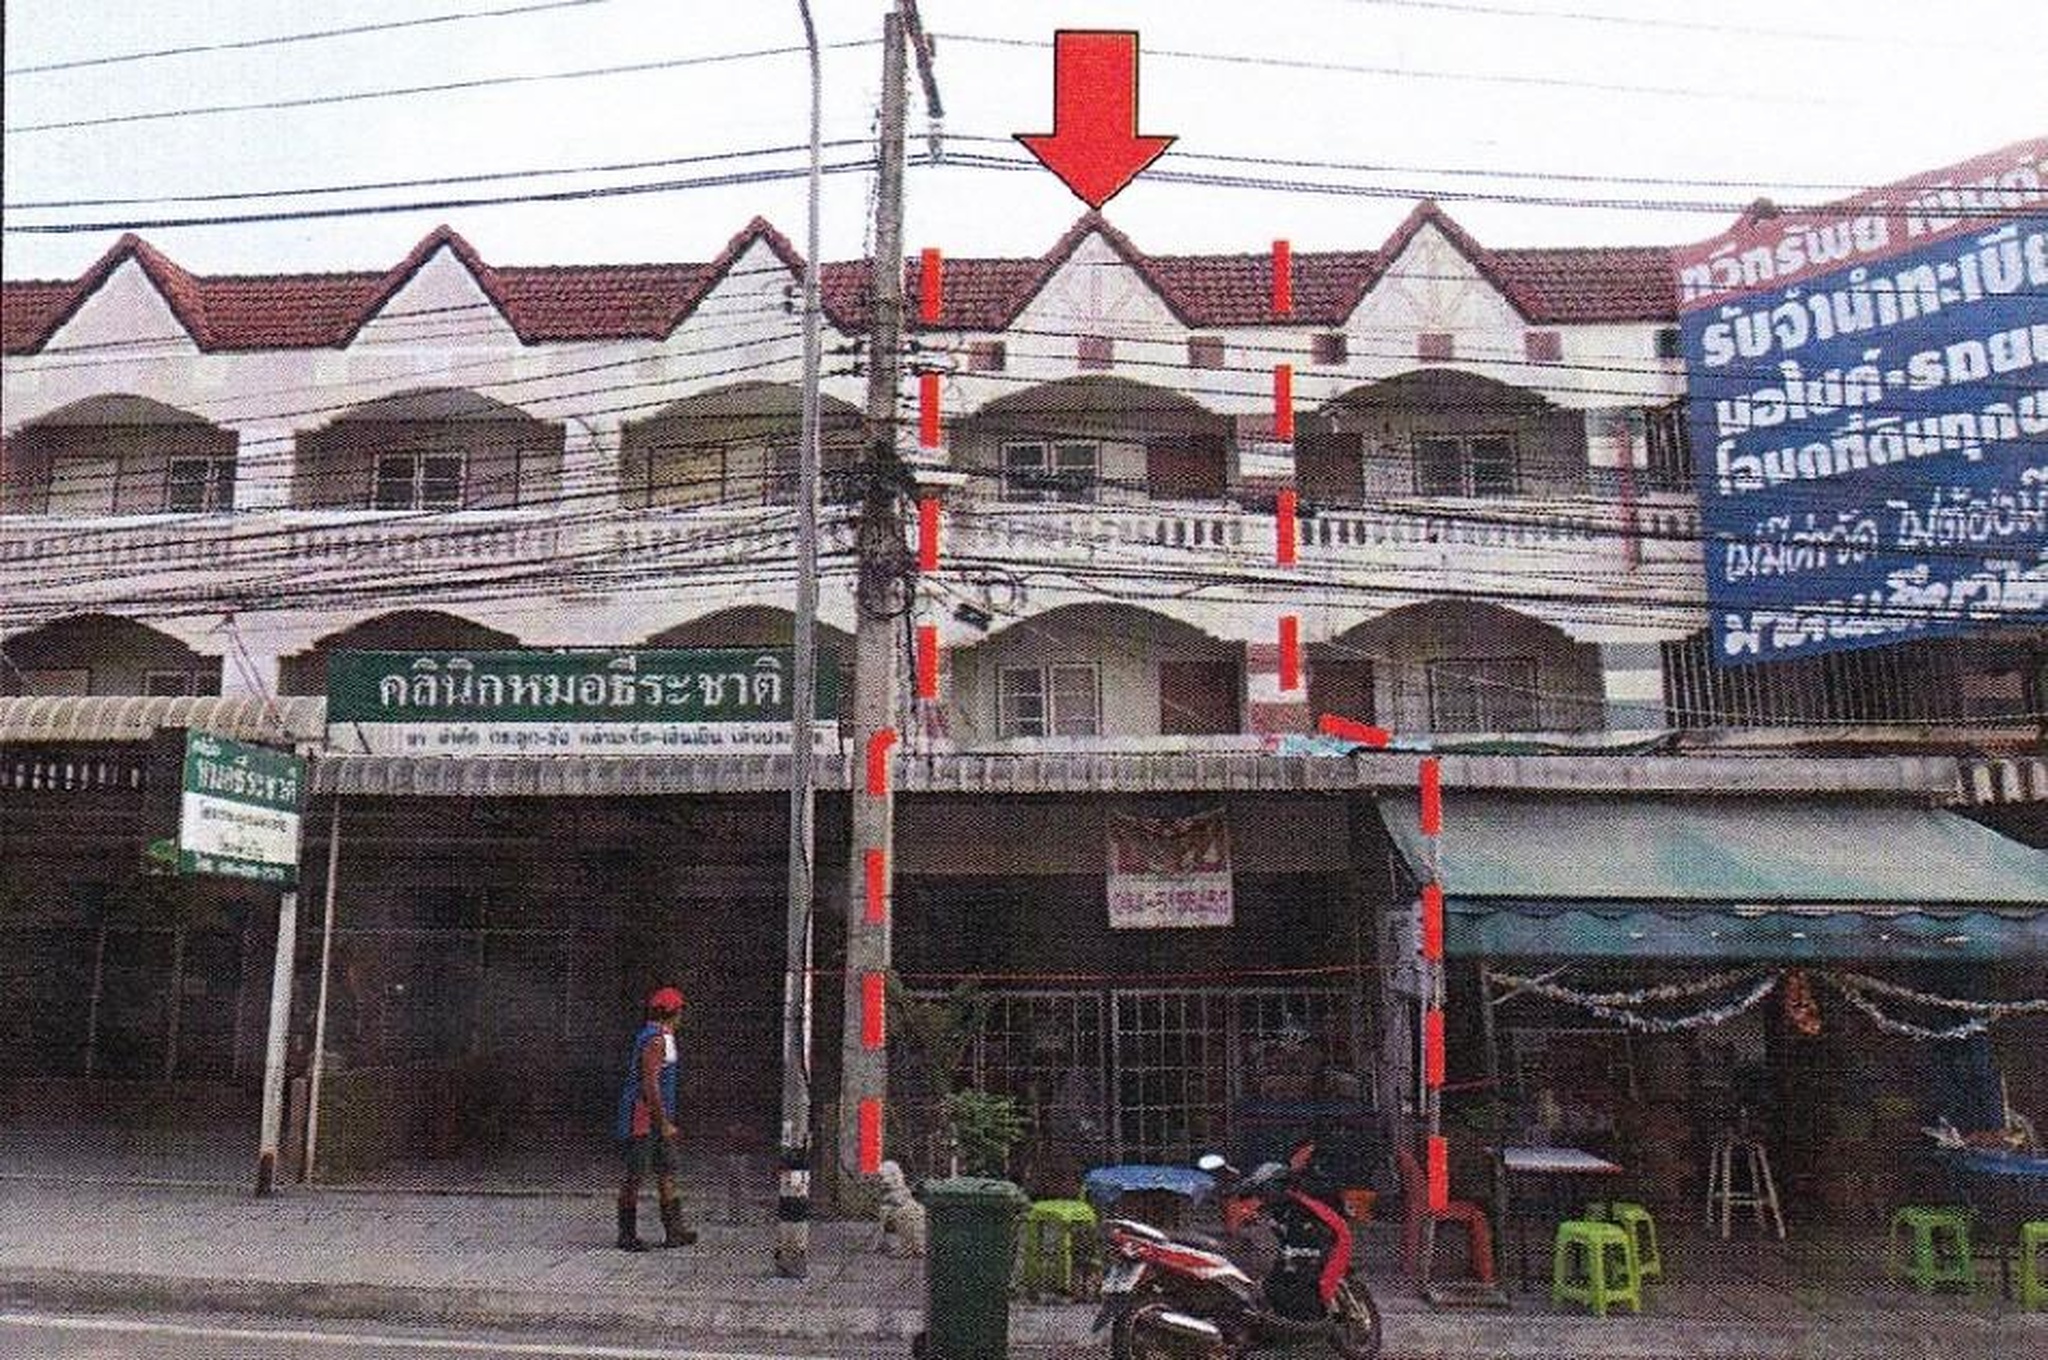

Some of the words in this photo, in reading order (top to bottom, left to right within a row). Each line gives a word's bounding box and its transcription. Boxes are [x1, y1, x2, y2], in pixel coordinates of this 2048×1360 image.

[380, 656, 782, 706] คลินิกหมอธีระชาติ
